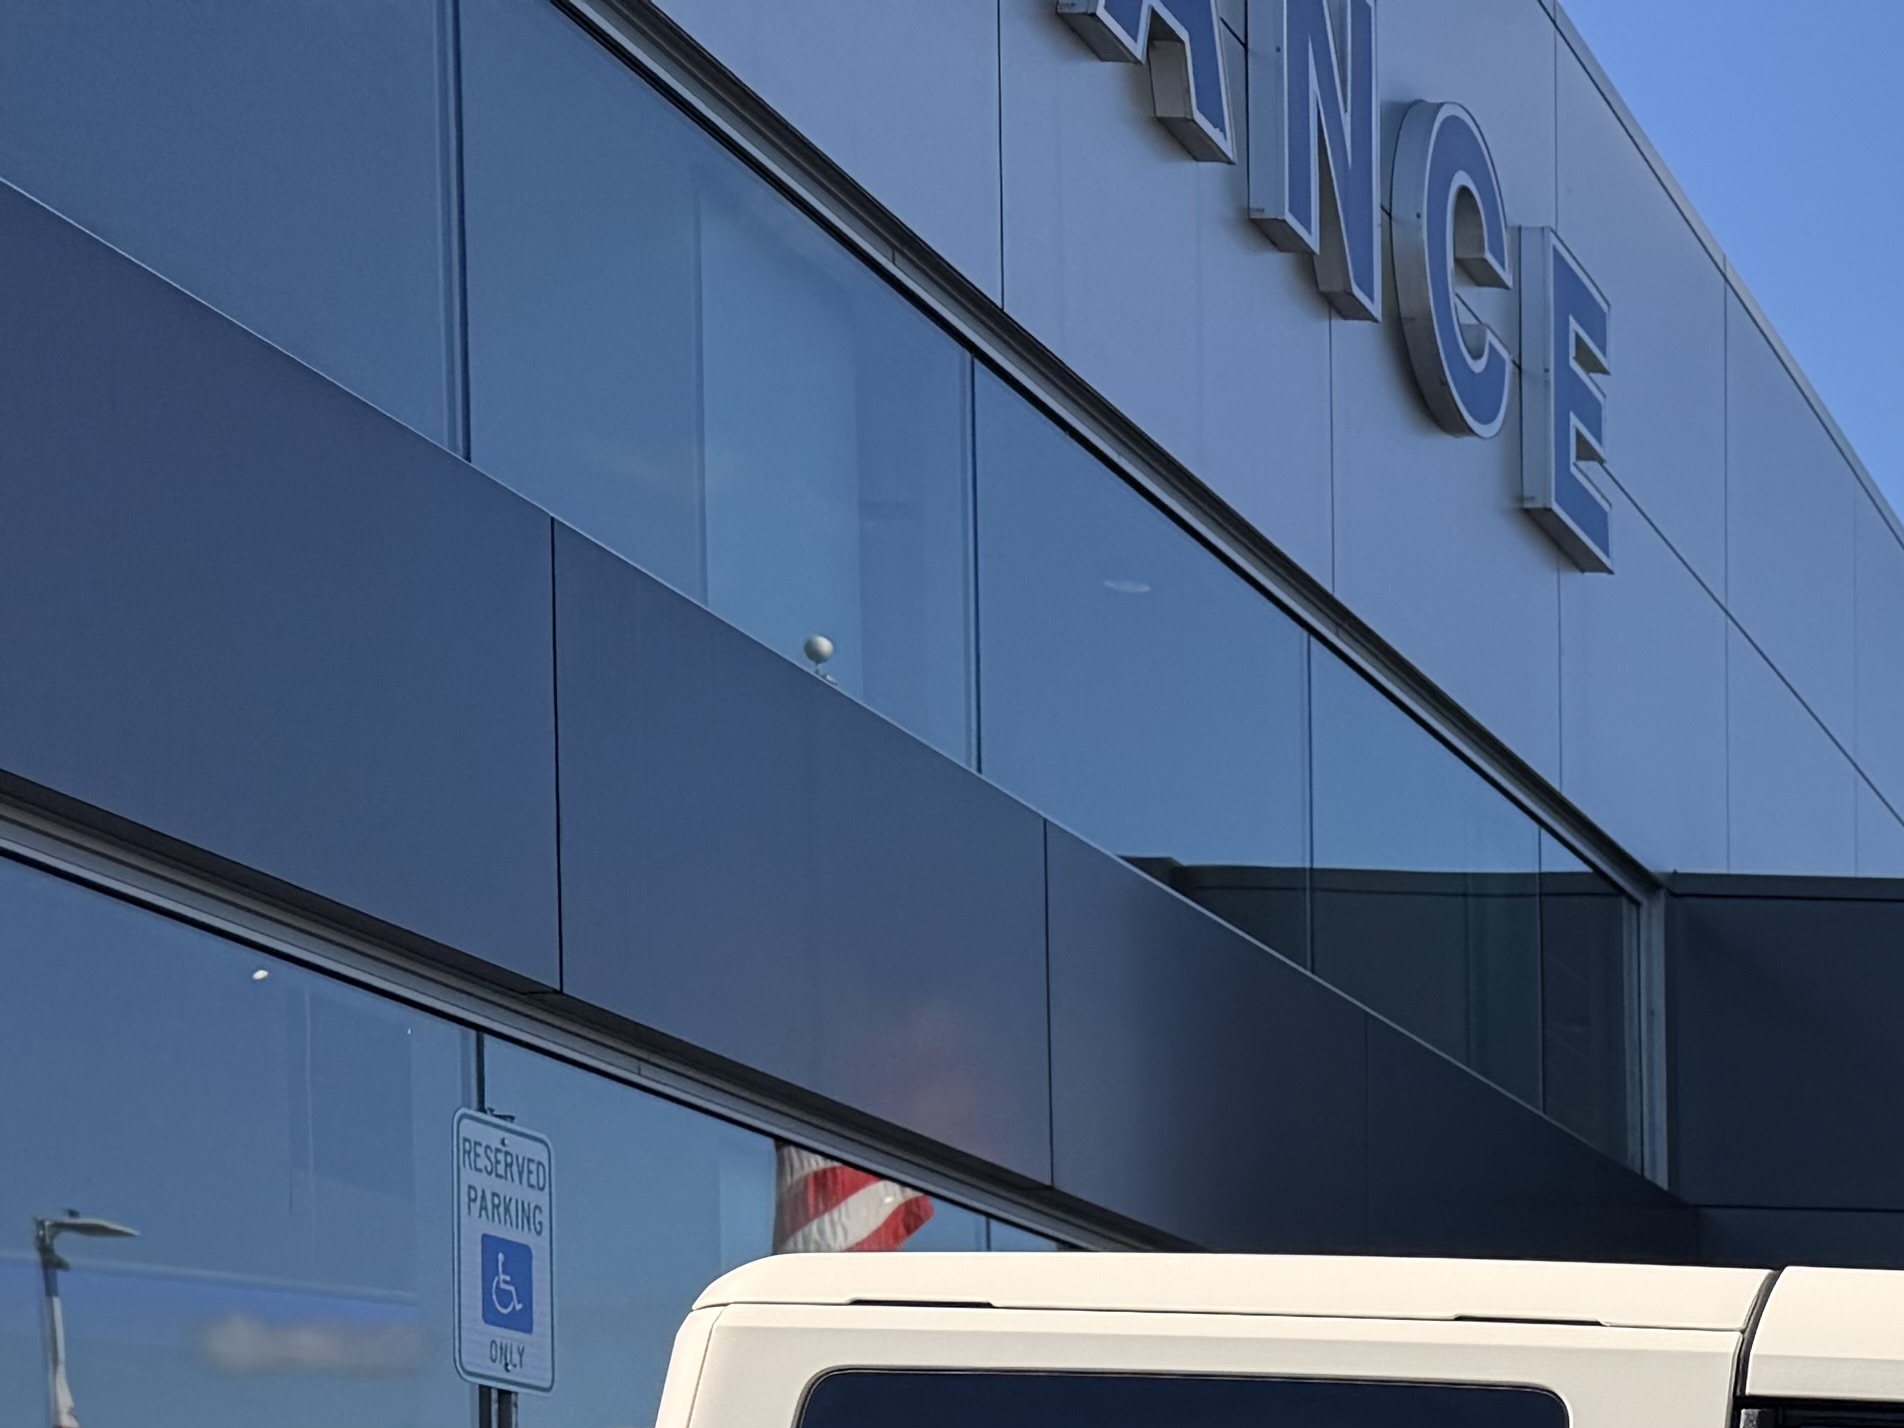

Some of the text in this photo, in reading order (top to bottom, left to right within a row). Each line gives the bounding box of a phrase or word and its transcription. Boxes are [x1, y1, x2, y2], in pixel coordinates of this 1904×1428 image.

[462, 1136, 547, 1192] RESERVED
[467, 1184, 544, 1236] PARKING
[489, 1339, 526, 1370] ONLY
